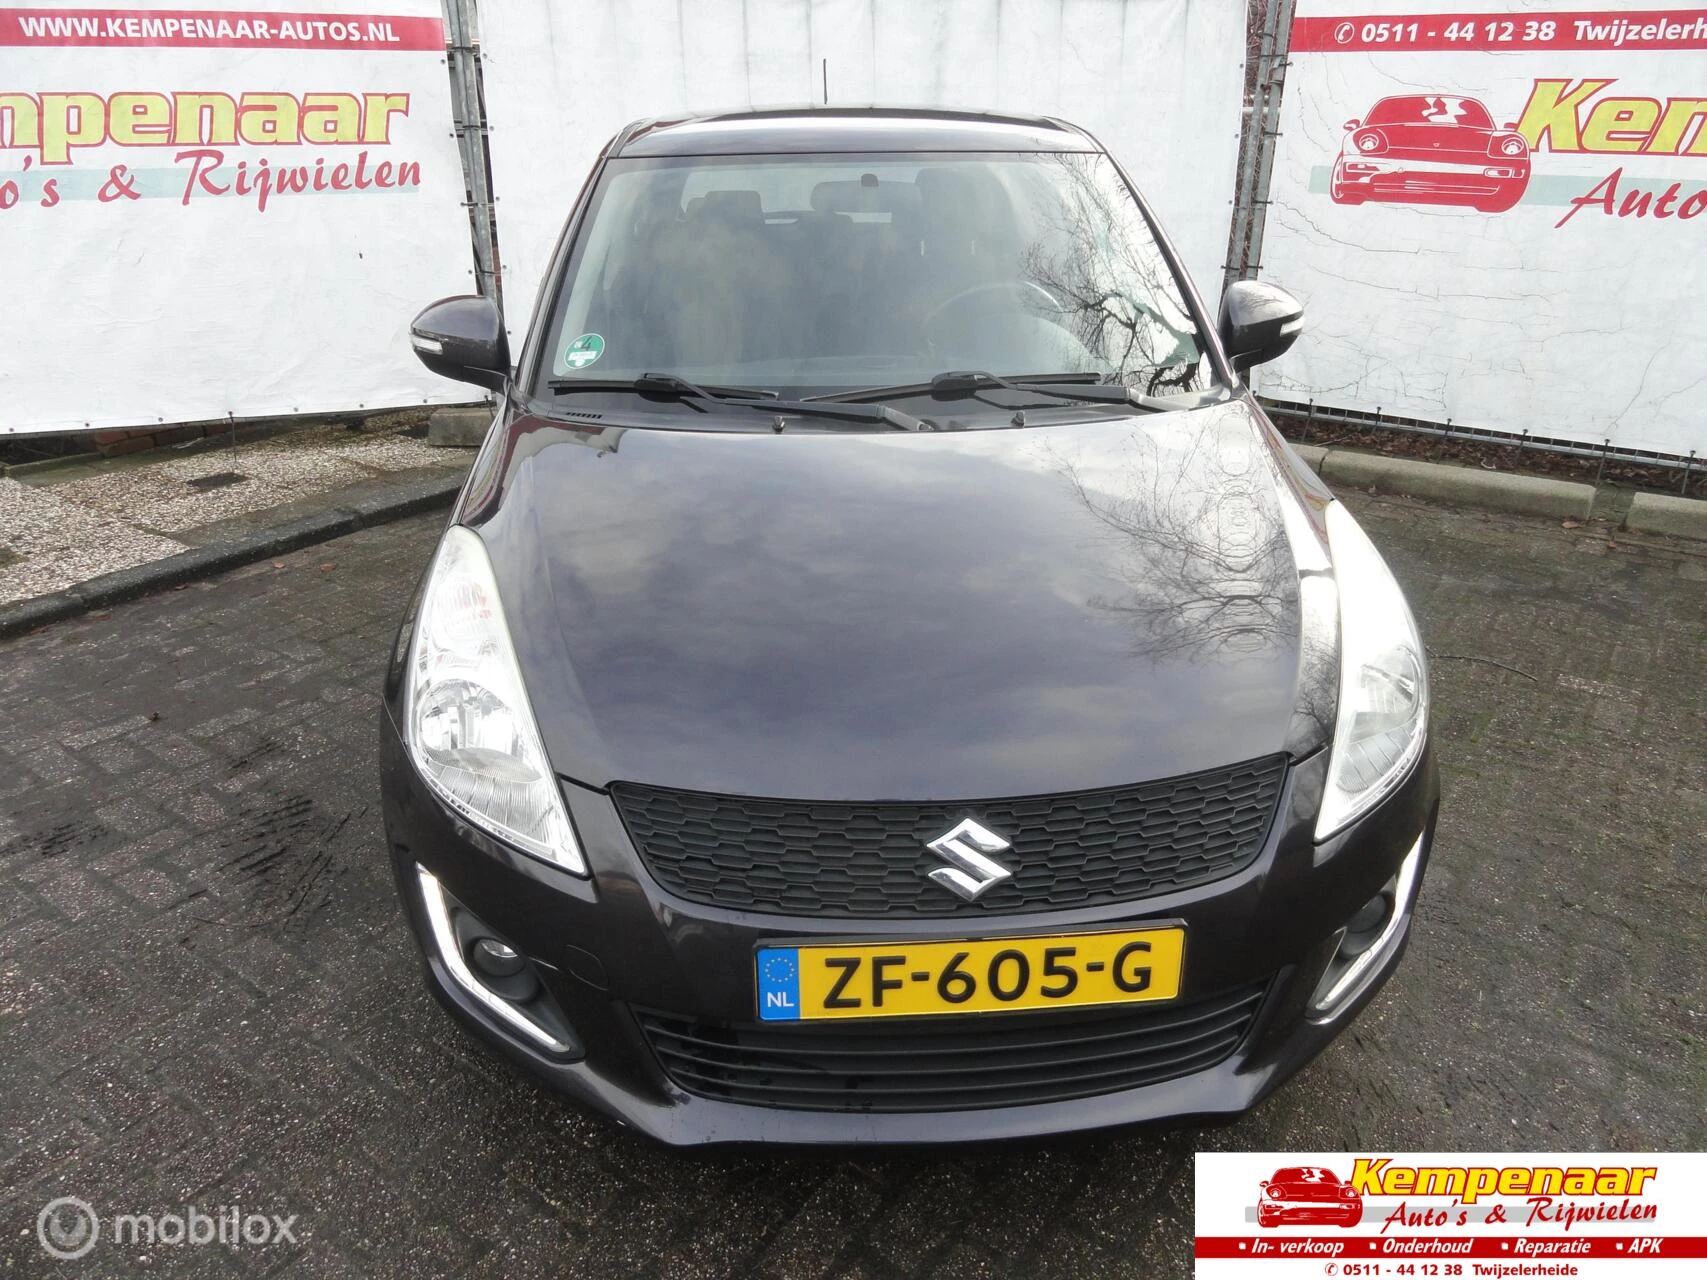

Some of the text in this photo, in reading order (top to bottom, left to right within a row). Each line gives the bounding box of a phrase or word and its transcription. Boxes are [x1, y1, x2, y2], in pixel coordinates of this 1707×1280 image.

[18, 16, 400, 42] WWW.KEMPENAAR-AUTOS.NL
[1361, 23, 1418, 43] 0511
[1443, 22, 1474, 41] 44
[1484, 22, 1513, 41] 12
[1522, 21, 1556, 40] 38
[98, 164, 141, 202] &
[175, 149, 420, 212] Rijwielen
[767, 942, 1152, 1009] NL ZF-605-G
